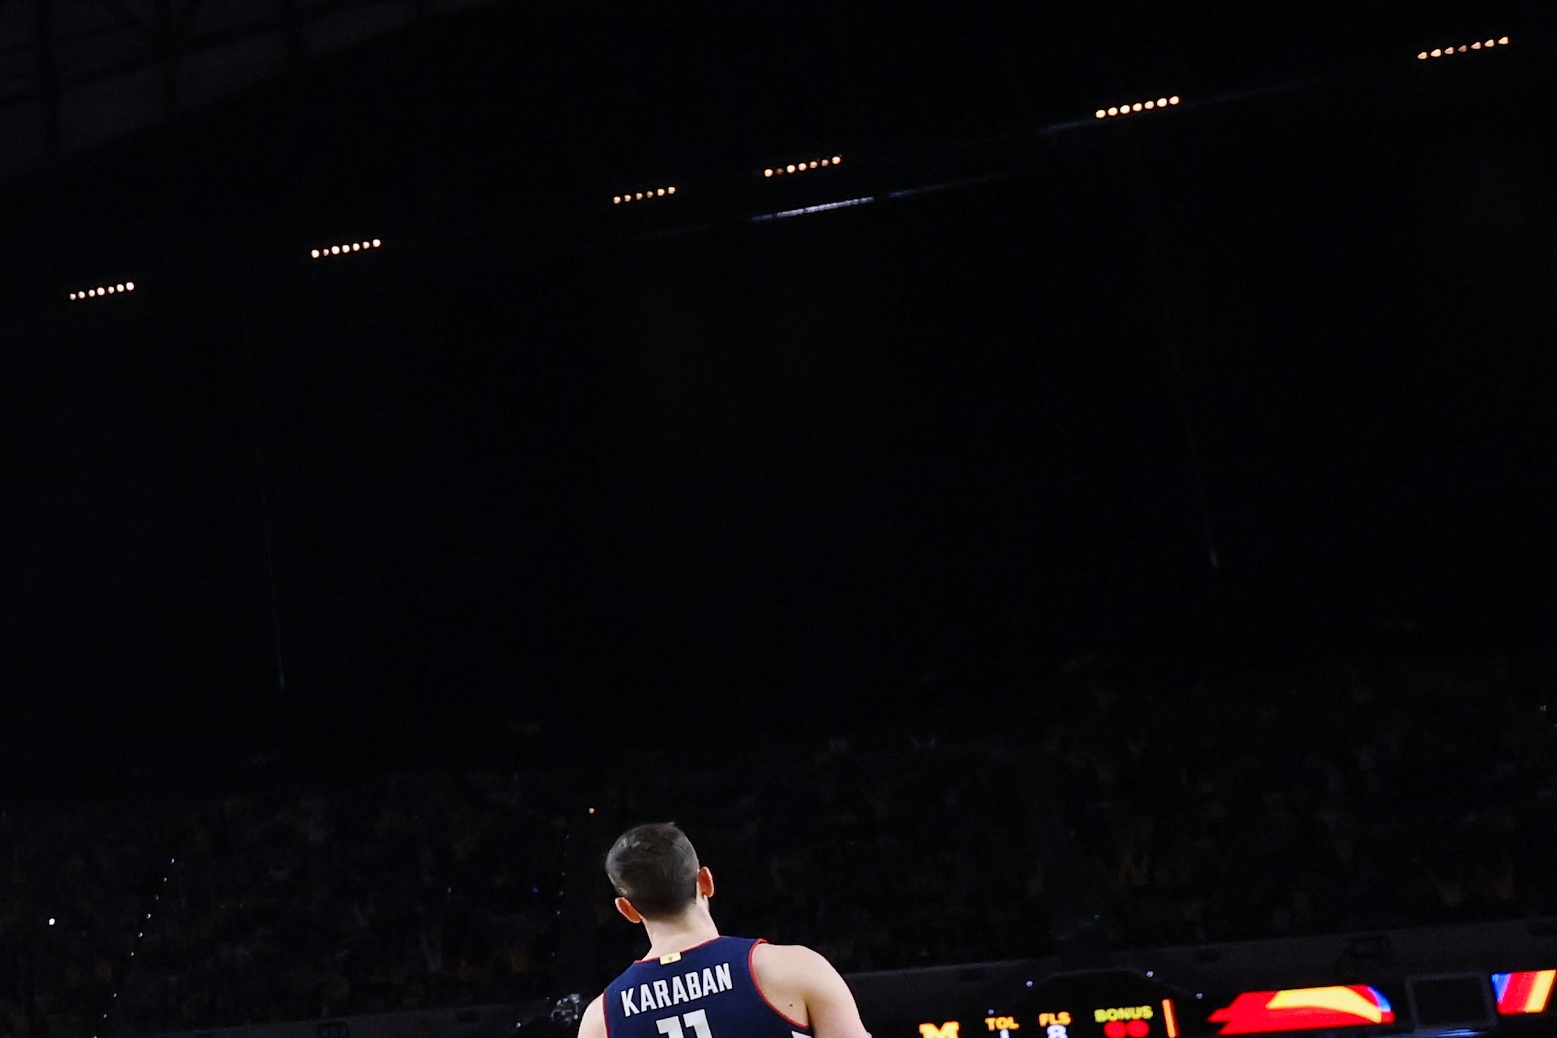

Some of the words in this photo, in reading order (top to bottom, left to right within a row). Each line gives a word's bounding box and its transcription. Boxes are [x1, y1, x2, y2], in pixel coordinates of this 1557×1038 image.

[621, 963, 733, 1017] KARABAN
[1039, 1012, 1072, 1027] FLS
[1094, 1005, 1153, 1023] BONUS
[985, 1016, 1019, 1032] TOL
